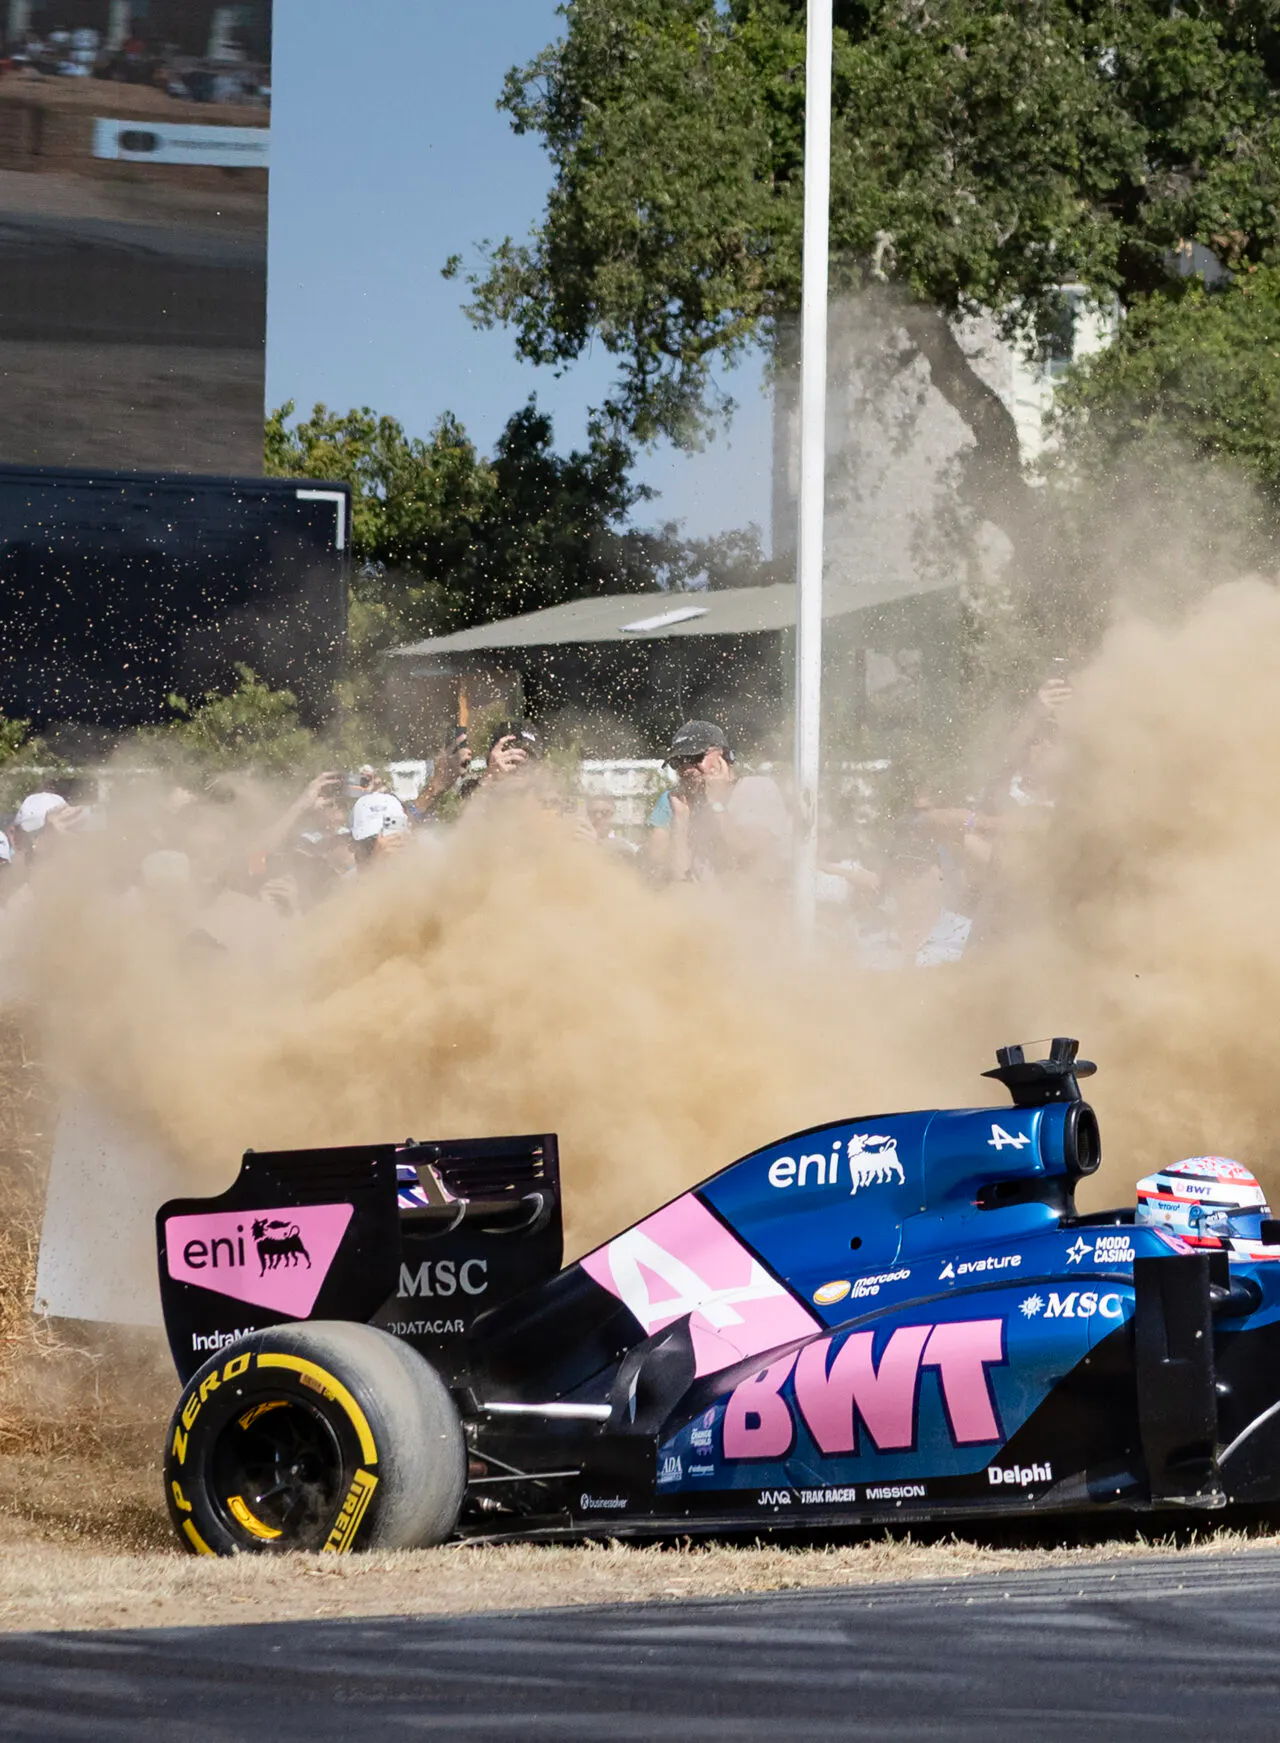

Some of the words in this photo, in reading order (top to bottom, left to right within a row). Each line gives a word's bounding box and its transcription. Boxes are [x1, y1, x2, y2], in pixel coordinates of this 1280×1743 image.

[767, 1140, 842, 1189] eni
[1186, 1185, 1212, 1196] BWT
[183, 1225, 245, 1268] eni
[1095, 1236, 1130, 1250] MODO
[956, 1254, 1022, 1275] avature
[1093, 1248, 1136, 1263] CASINO
[395, 1259, 488, 1298] MSC
[853, 1269, 911, 1287] mercado
[850, 1284, 880, 1299] libre
[1043, 1292, 1122, 1318] MSC
[724, 1319, 1003, 1459] BWT
[173, 1352, 252, 1465] ZERO
[662, 1456, 682, 1473] ADA
[988, 1462, 1053, 1487] Delphi
[801, 1490, 824, 1503] TRAK
[825, 1488, 855, 1502] RACER
[866, 1485, 925, 1499] MISSION
